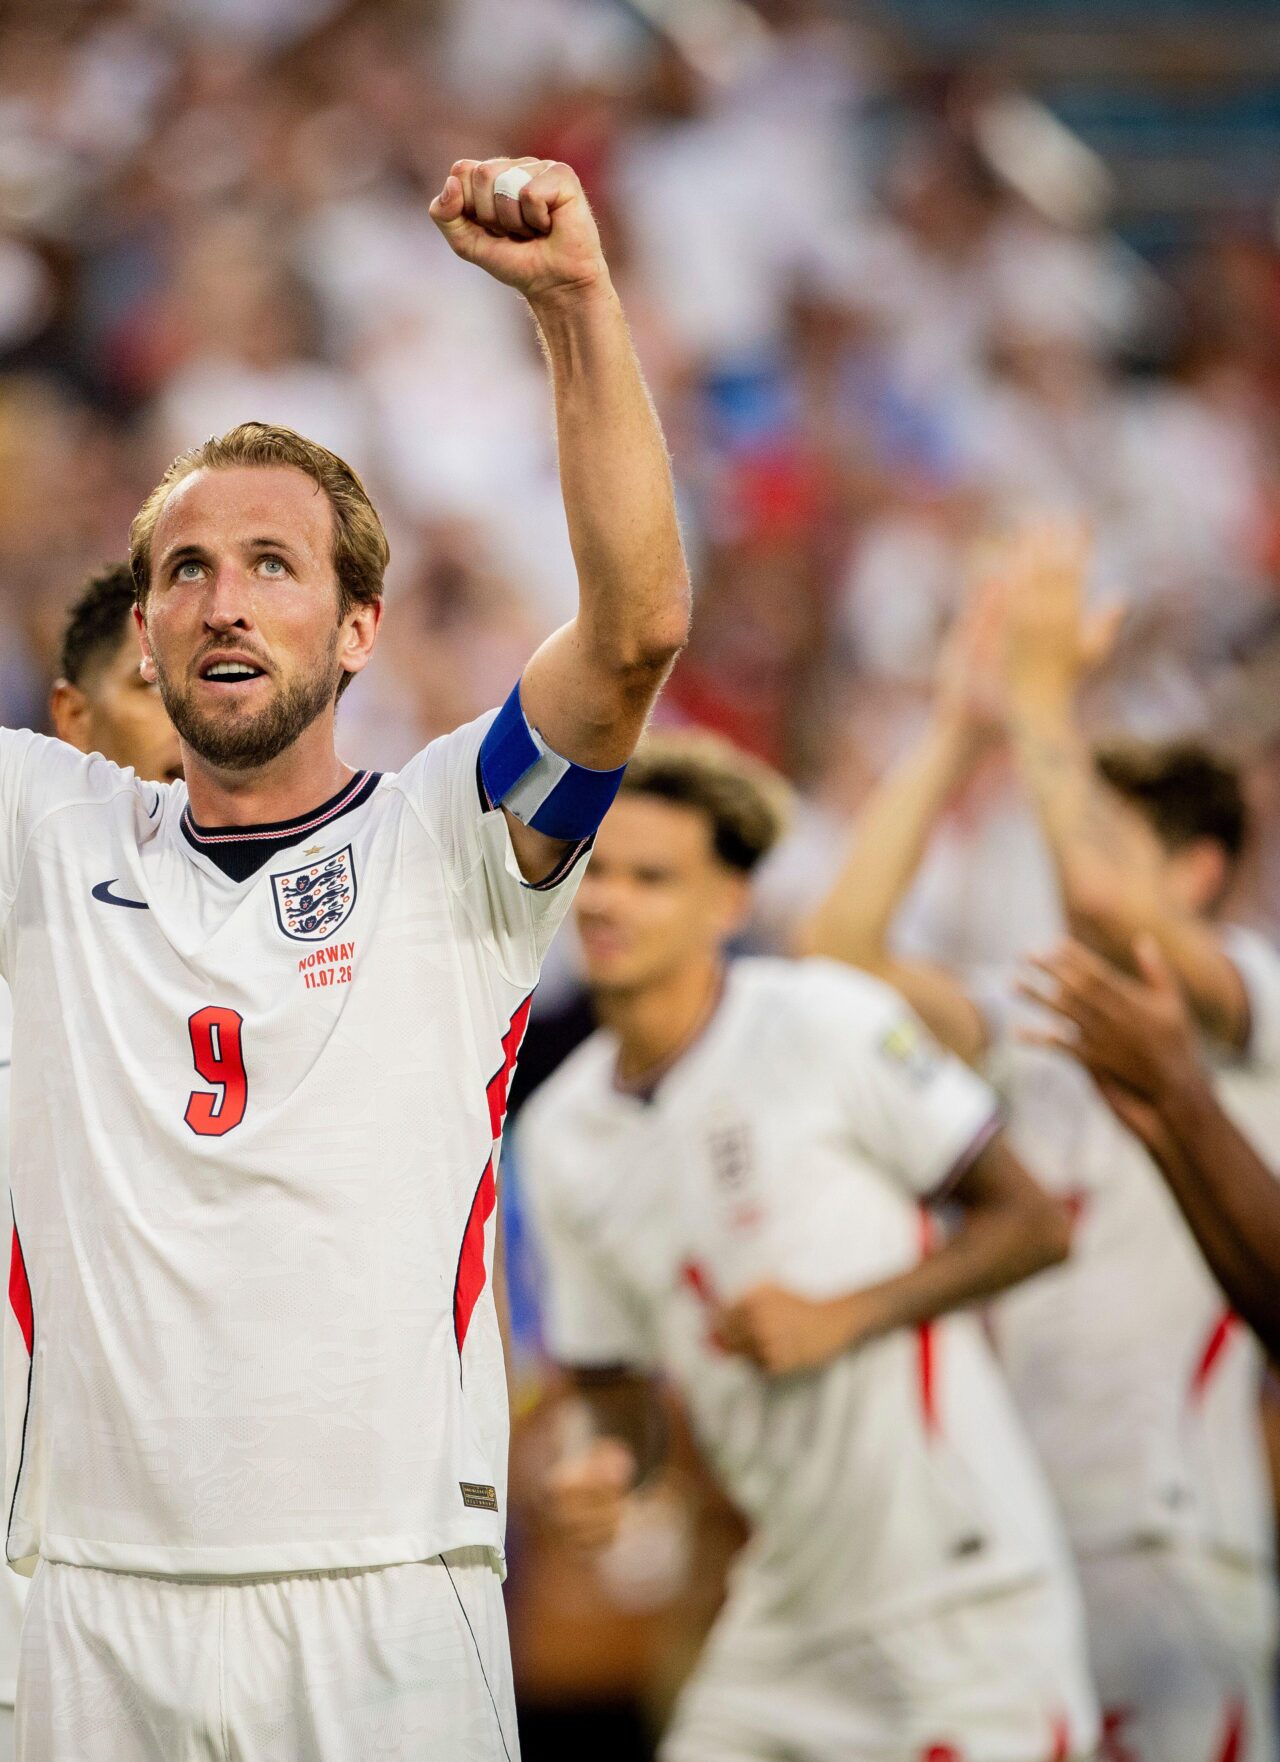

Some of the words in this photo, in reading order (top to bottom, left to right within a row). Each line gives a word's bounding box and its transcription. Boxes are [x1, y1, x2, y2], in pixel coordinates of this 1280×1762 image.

[298, 942, 355, 972] NORWAY
[304, 965, 352, 989] 11.07.26
[184, 1005, 248, 1137] 9
